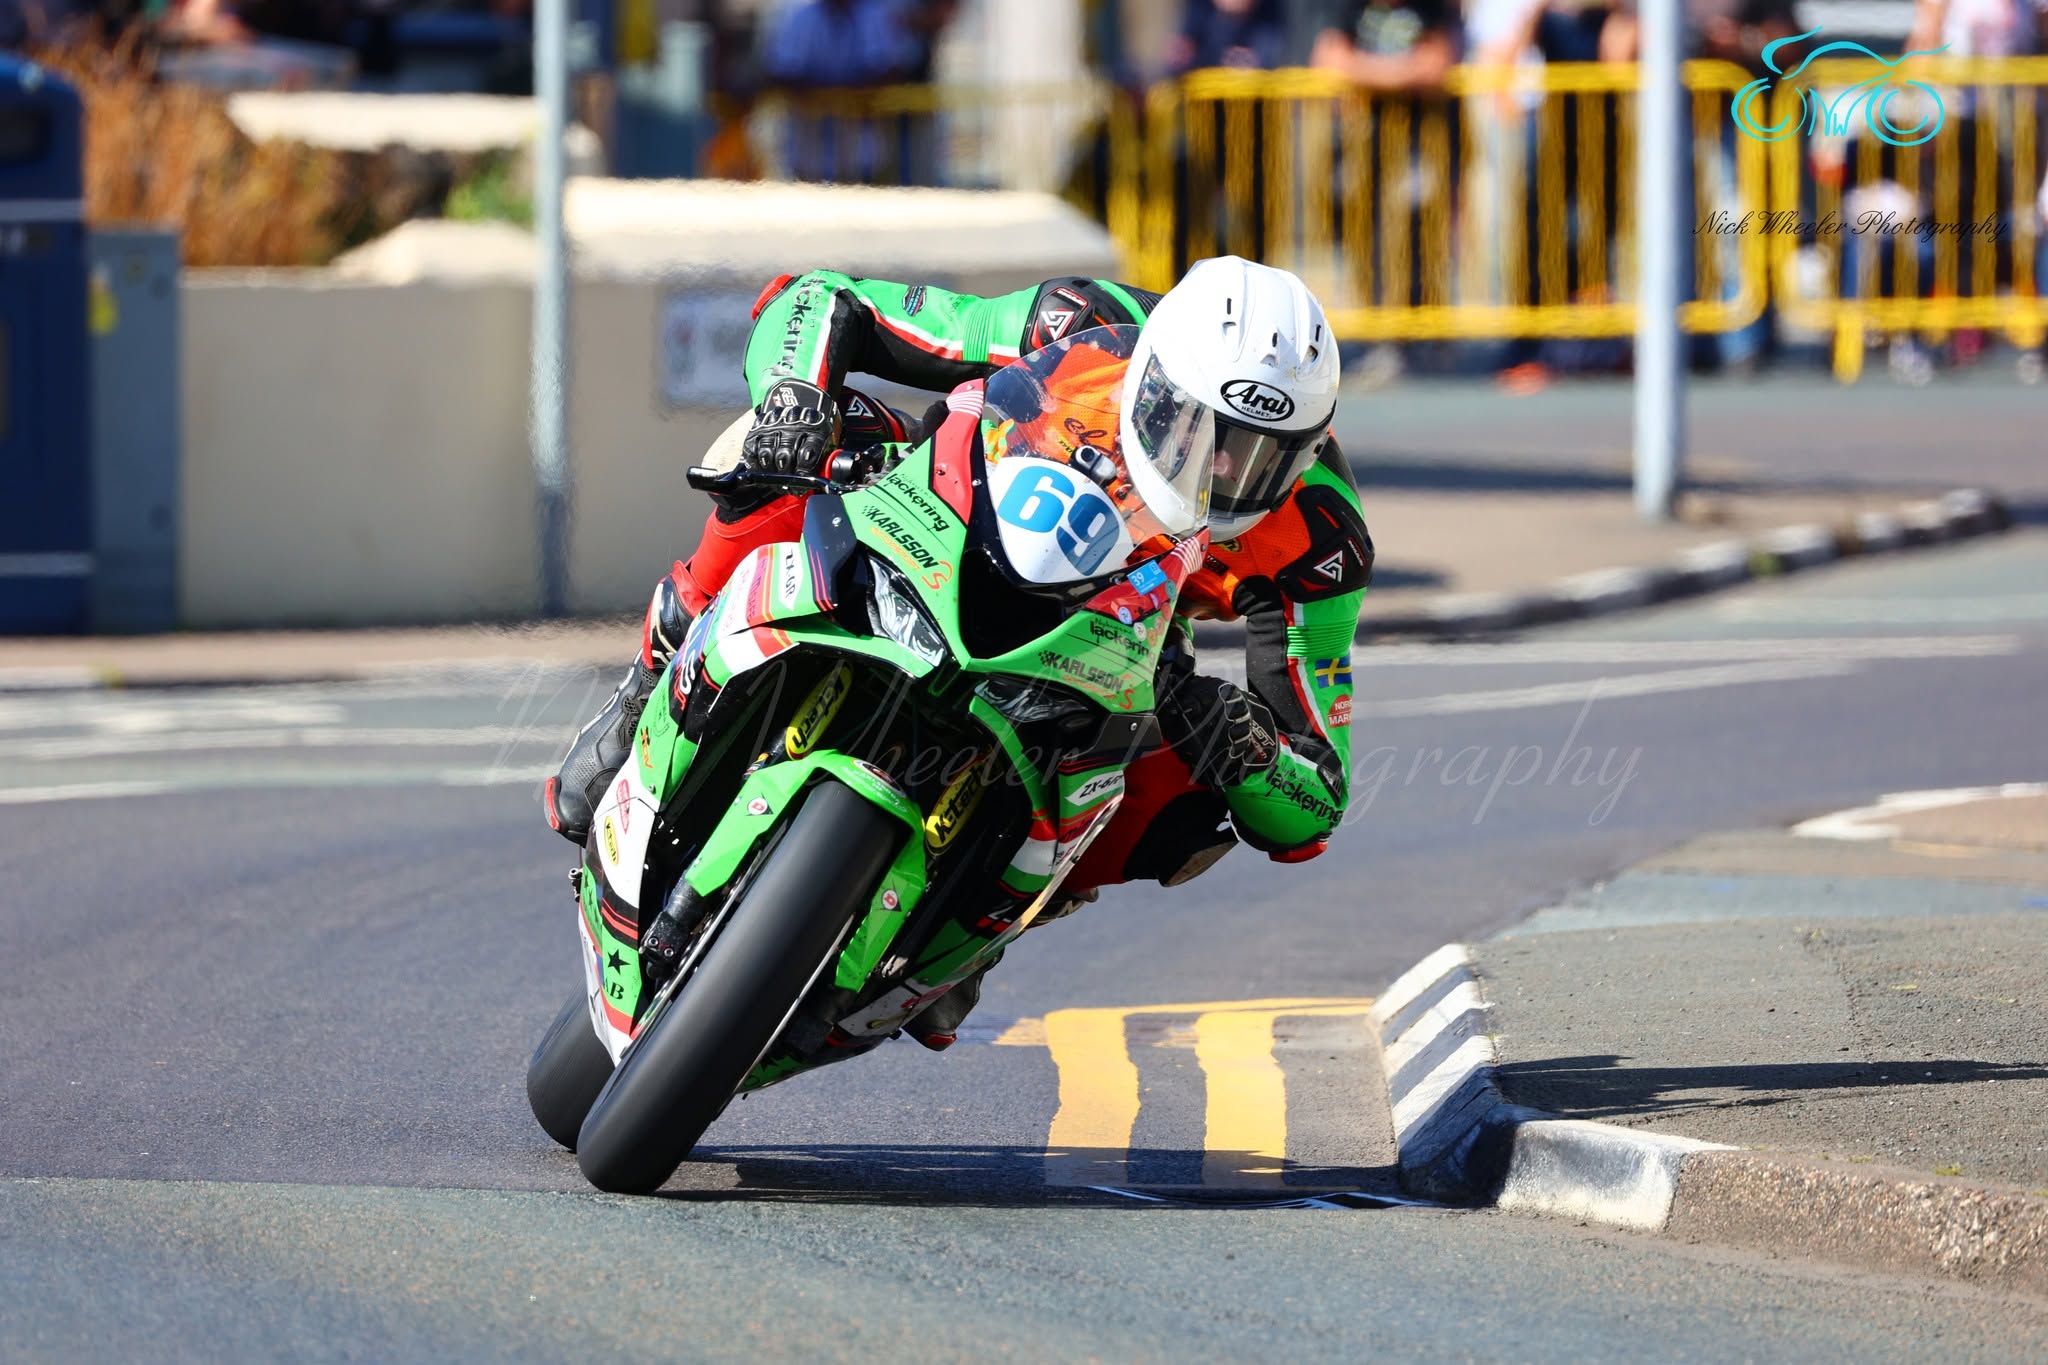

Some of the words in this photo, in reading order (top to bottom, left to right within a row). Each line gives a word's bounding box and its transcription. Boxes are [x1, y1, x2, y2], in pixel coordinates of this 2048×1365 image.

[780, 387, 799, 406] RS
[1223, 384, 1289, 415] Arai
[1241, 405, 1271, 418] HELMET
[997, 465, 1120, 576] 69
[866, 508, 940, 569] KARLSSON
[1131, 571, 1145, 586] 39
[1044, 651, 1123, 694] KARLSSON
